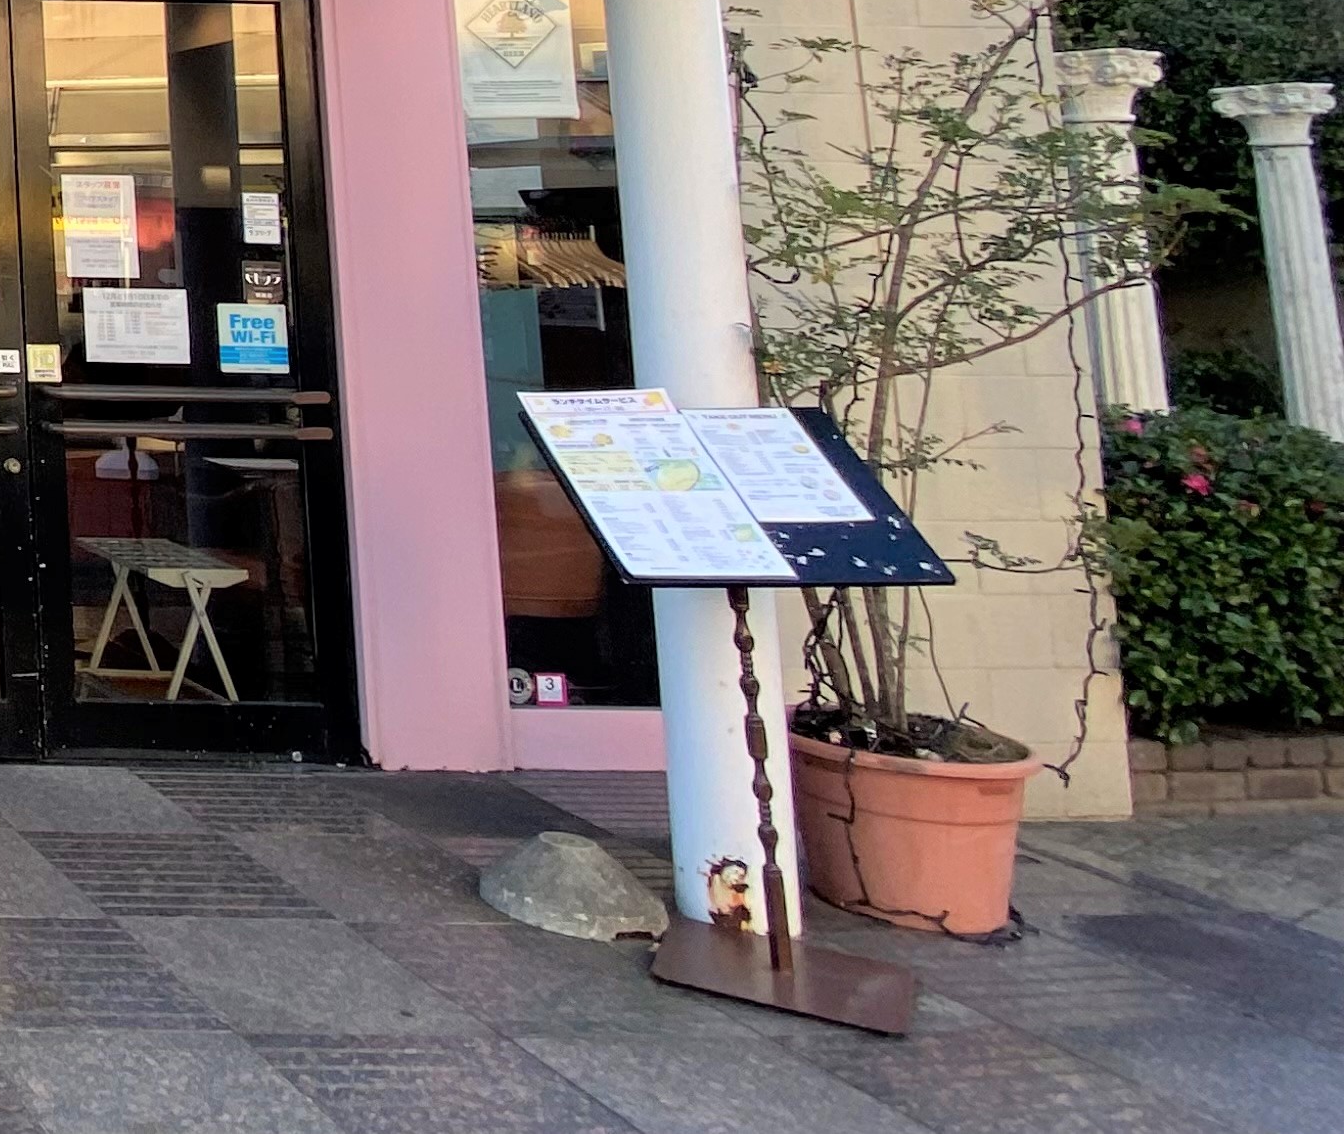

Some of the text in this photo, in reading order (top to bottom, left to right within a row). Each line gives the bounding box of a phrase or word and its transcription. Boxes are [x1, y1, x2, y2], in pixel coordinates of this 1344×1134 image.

[480, 0, 544, 24] HEARTLAND
[228, 313, 276, 329] Free
[544, 677, 555, 691] 3
